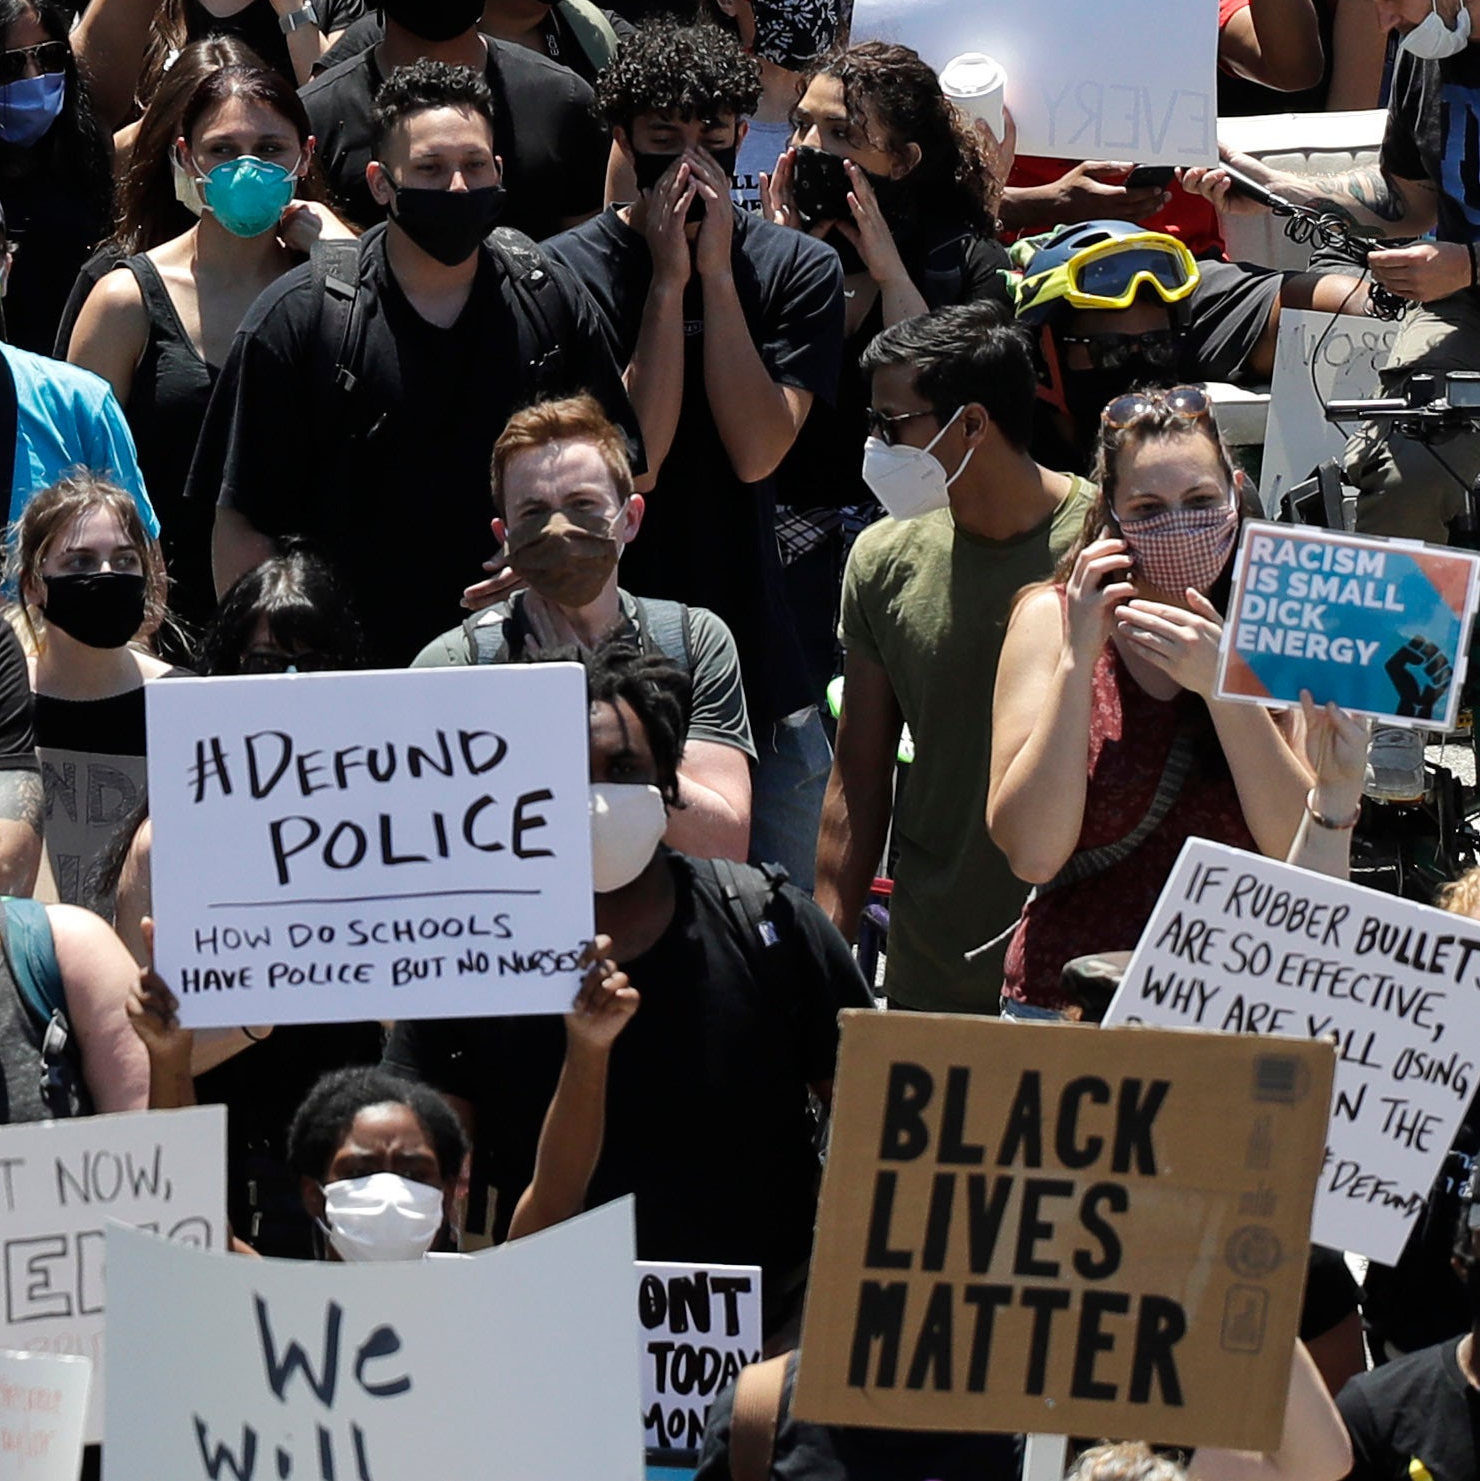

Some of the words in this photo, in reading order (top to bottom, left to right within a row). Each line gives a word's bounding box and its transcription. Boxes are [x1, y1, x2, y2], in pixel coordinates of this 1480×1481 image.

[1245, 563, 1281, 592] IS
[1286, 572, 1406, 613] SMALL
[1249, 535, 1387, 578] RACISM
[1240, 593, 1329, 631] DICK
[1235, 625, 1380, 667] ENERGY
[186, 729, 508, 804] #DEFUND
[269, 788, 556, 886] POLICE
[194, 926, 271, 954] HOW
[288, 921, 336, 949] DO
[347, 913, 514, 948] SCHOOLS
[180, 965, 254, 995] HAVE
[267, 961, 373, 988] POLICE
[391, 958, 444, 986] BUT
[456, 950, 491, 976] NO
[1155, 911, 1227, 967] ARE
[1222, 931, 1273, 977] SO
[1276, 952, 1447, 1044] EFFECTIVE,
[878, 1061, 1172, 1177] BLACK
[1379, 1096, 1444, 1153] THE
[54, 1142, 173, 1207] NOW,
[862, 1169, 1132, 1282] LIVES
[254, 1290, 412, 1410] We
[846, 1279, 1189, 1408] MATTER
